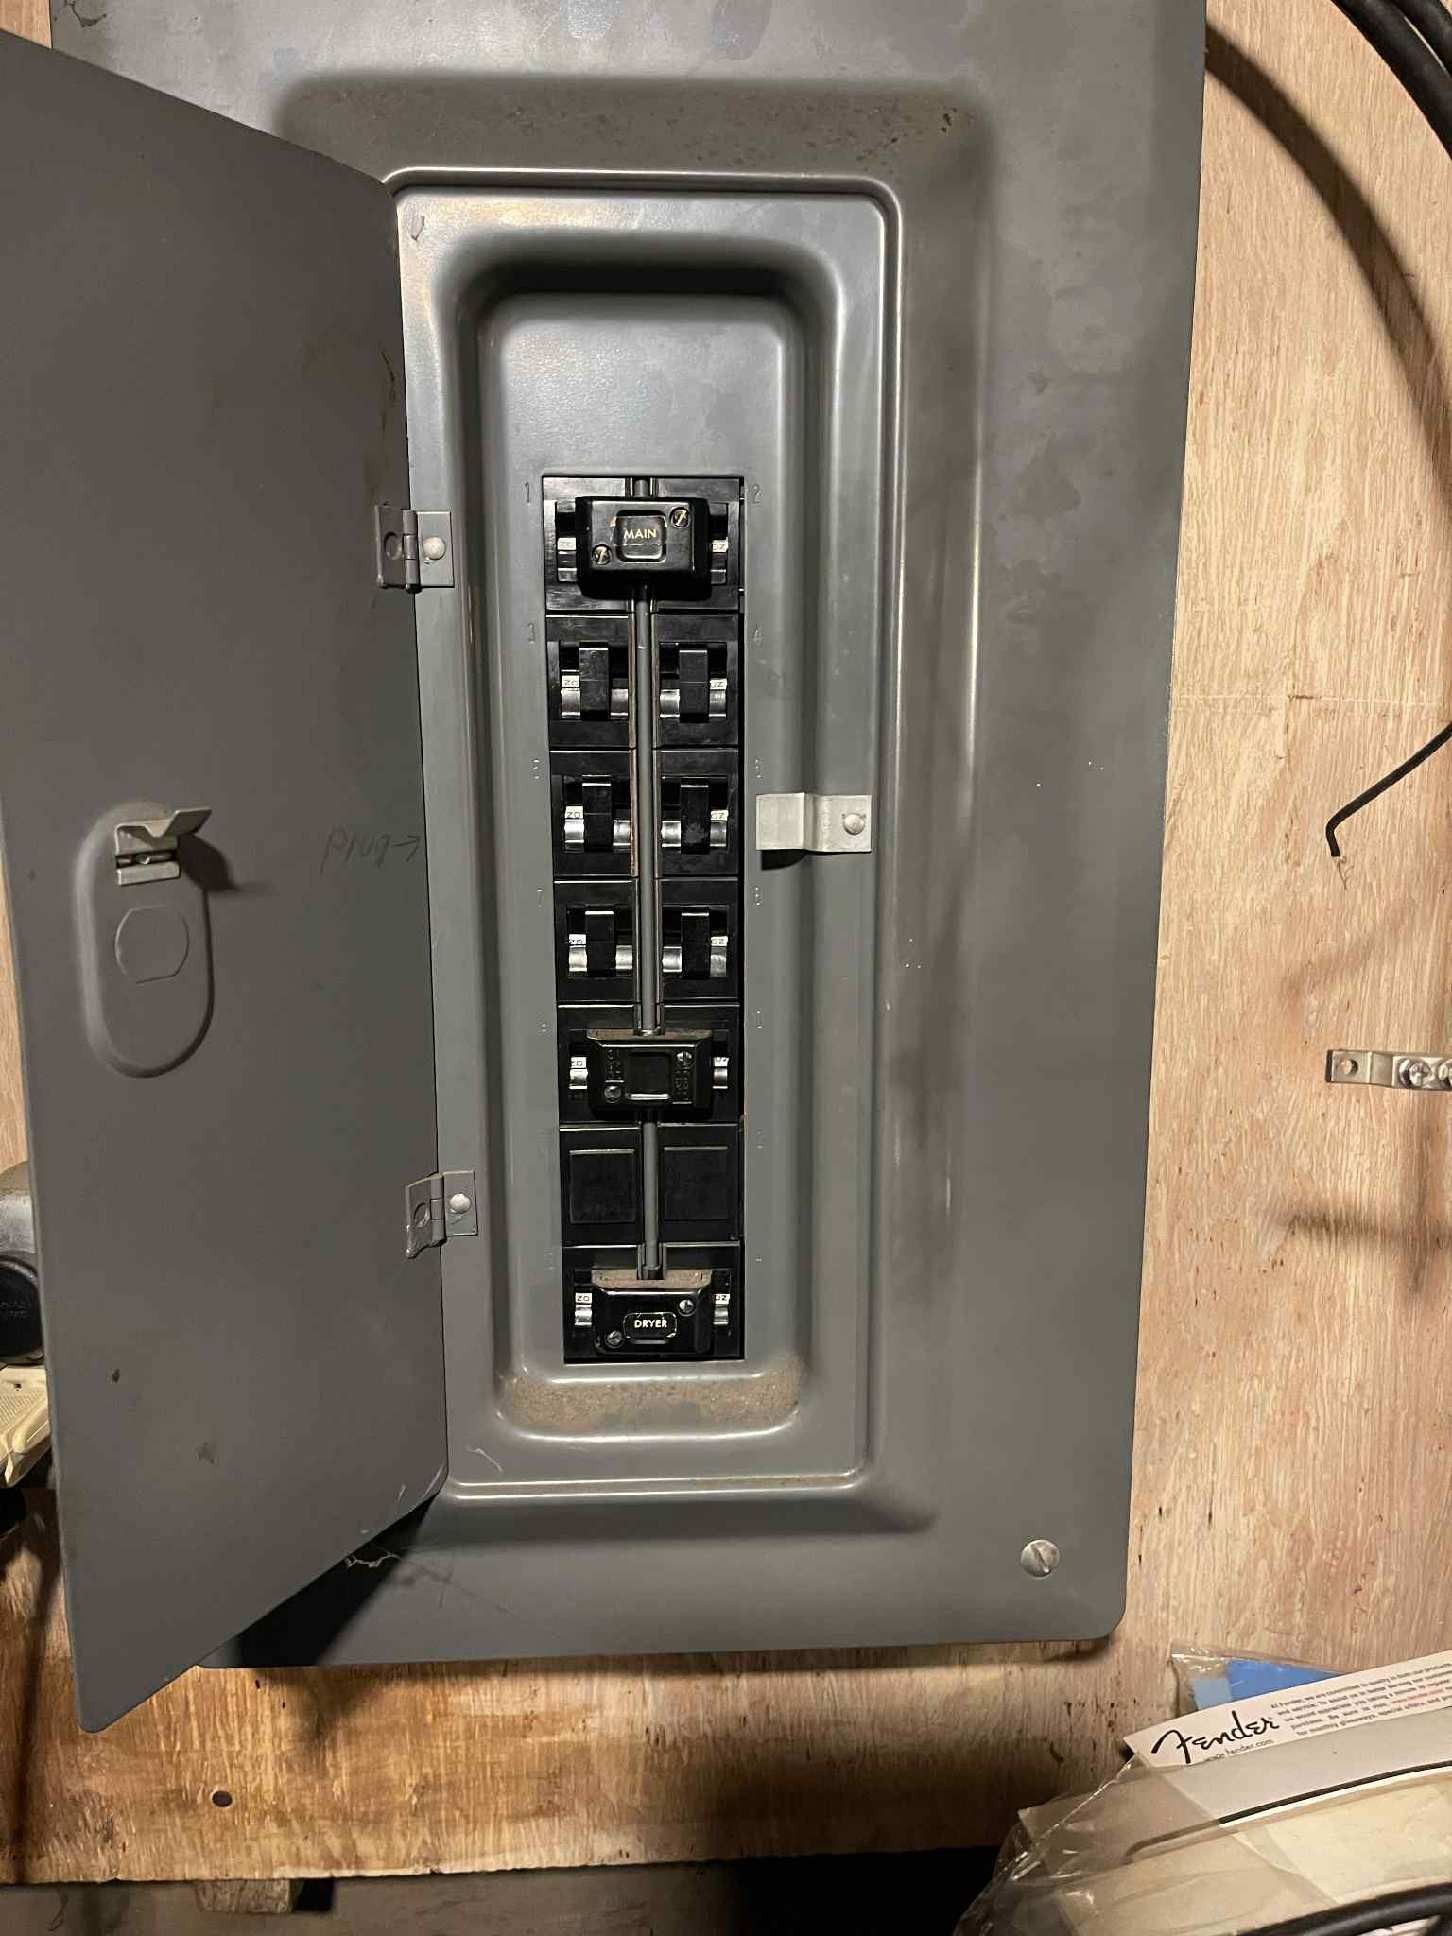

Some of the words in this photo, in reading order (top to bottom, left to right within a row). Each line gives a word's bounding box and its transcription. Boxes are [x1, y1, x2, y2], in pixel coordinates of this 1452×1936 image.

[623, 528, 657, 539] MAIN
[633, 1319, 668, 1328] DRYER
[1151, 1710, 1280, 1764] Fender
